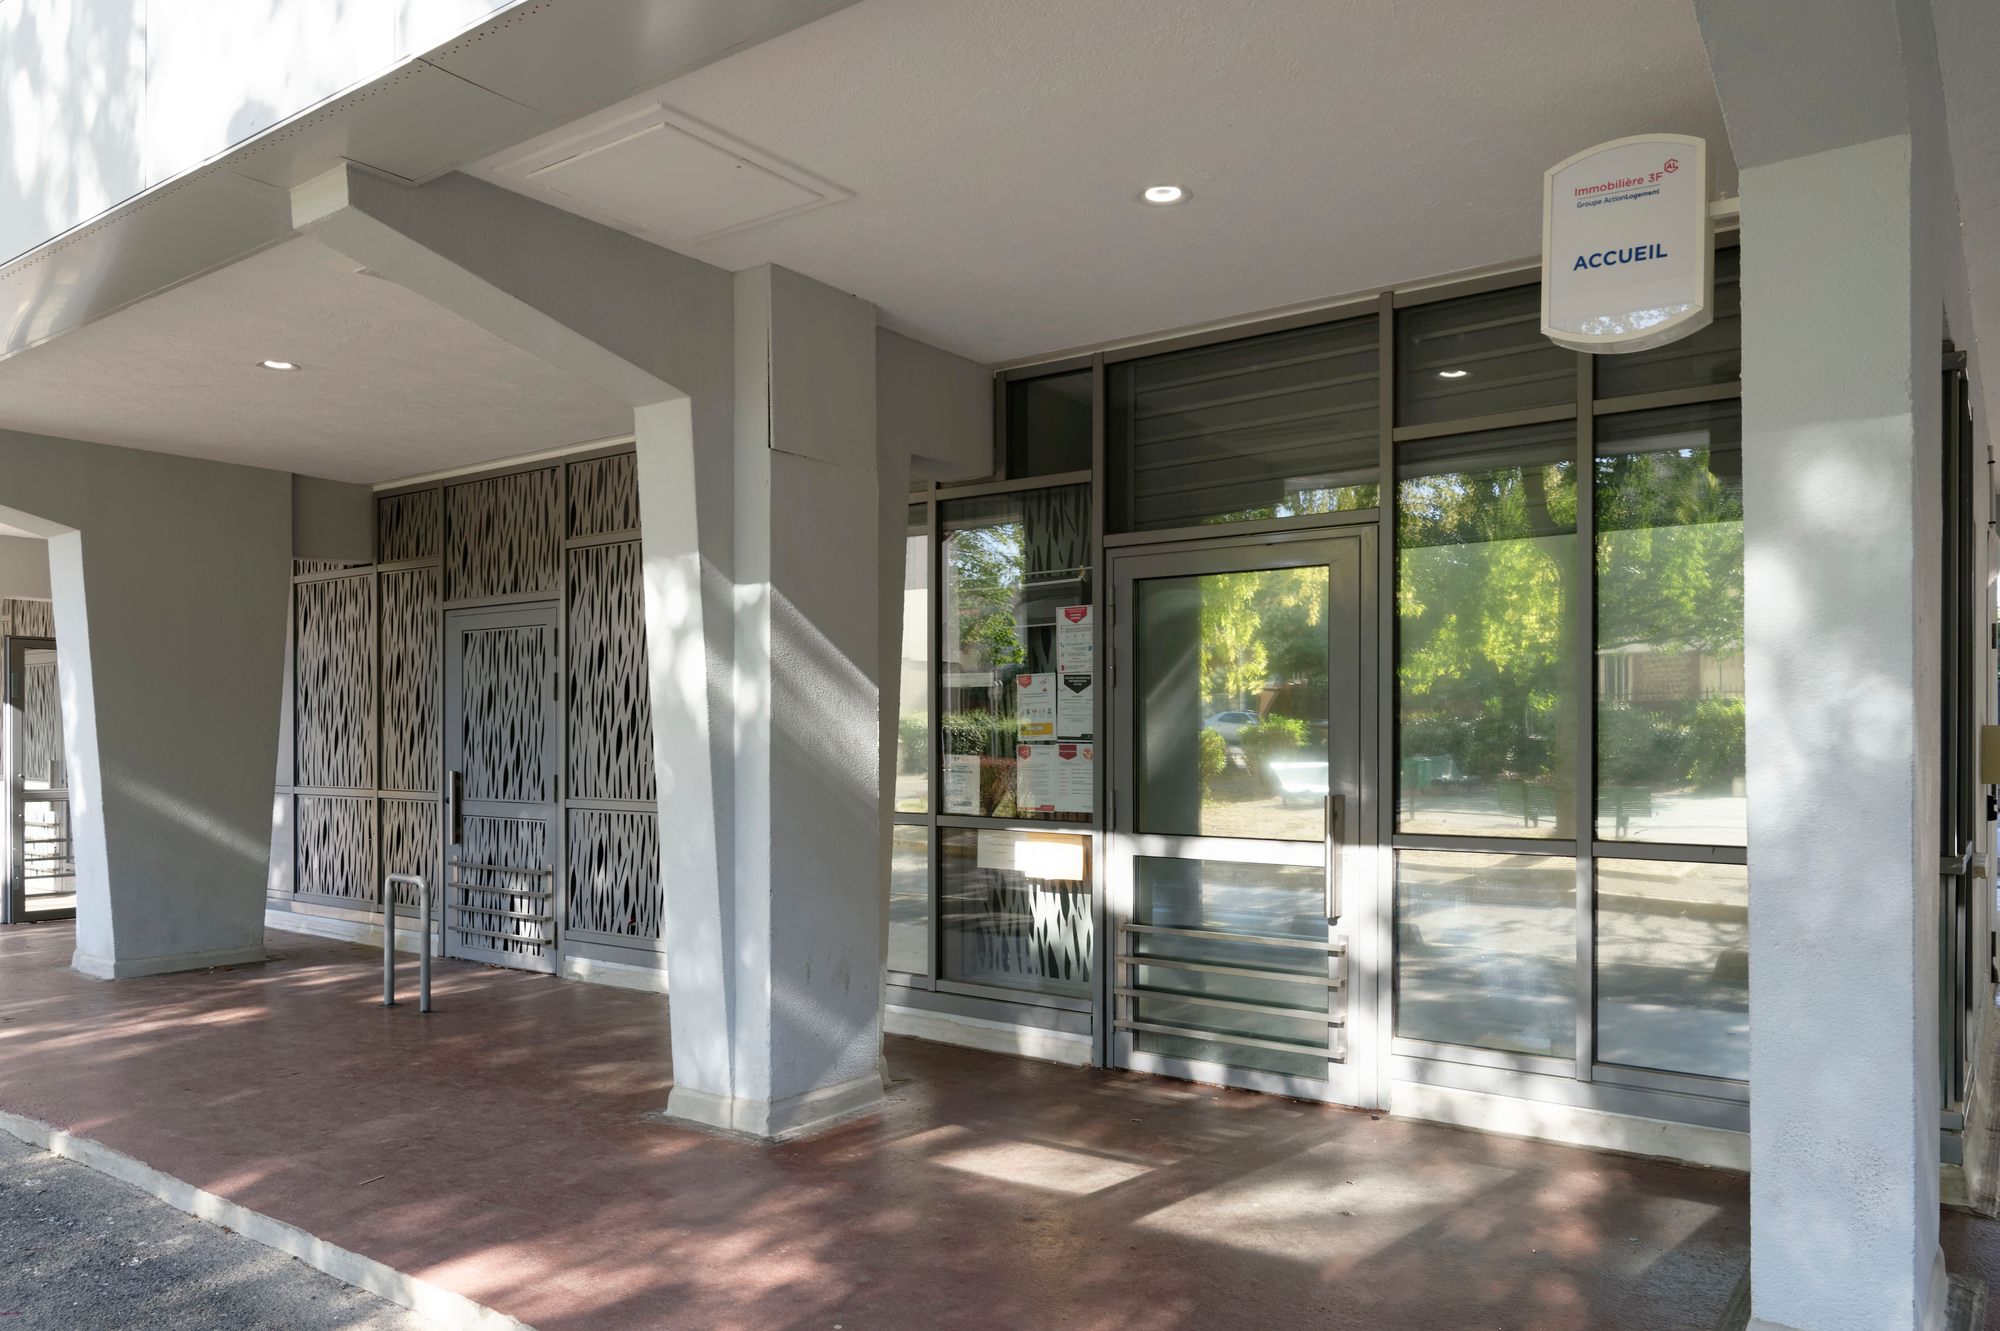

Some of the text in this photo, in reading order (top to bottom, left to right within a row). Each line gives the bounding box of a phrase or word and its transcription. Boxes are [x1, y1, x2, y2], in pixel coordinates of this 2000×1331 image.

[1574, 172, 1663, 197] Immobilière 3F
[1576, 189, 1660, 209] Groupe ActionLogement
[1573, 243, 1668, 271] ACCUEIL
